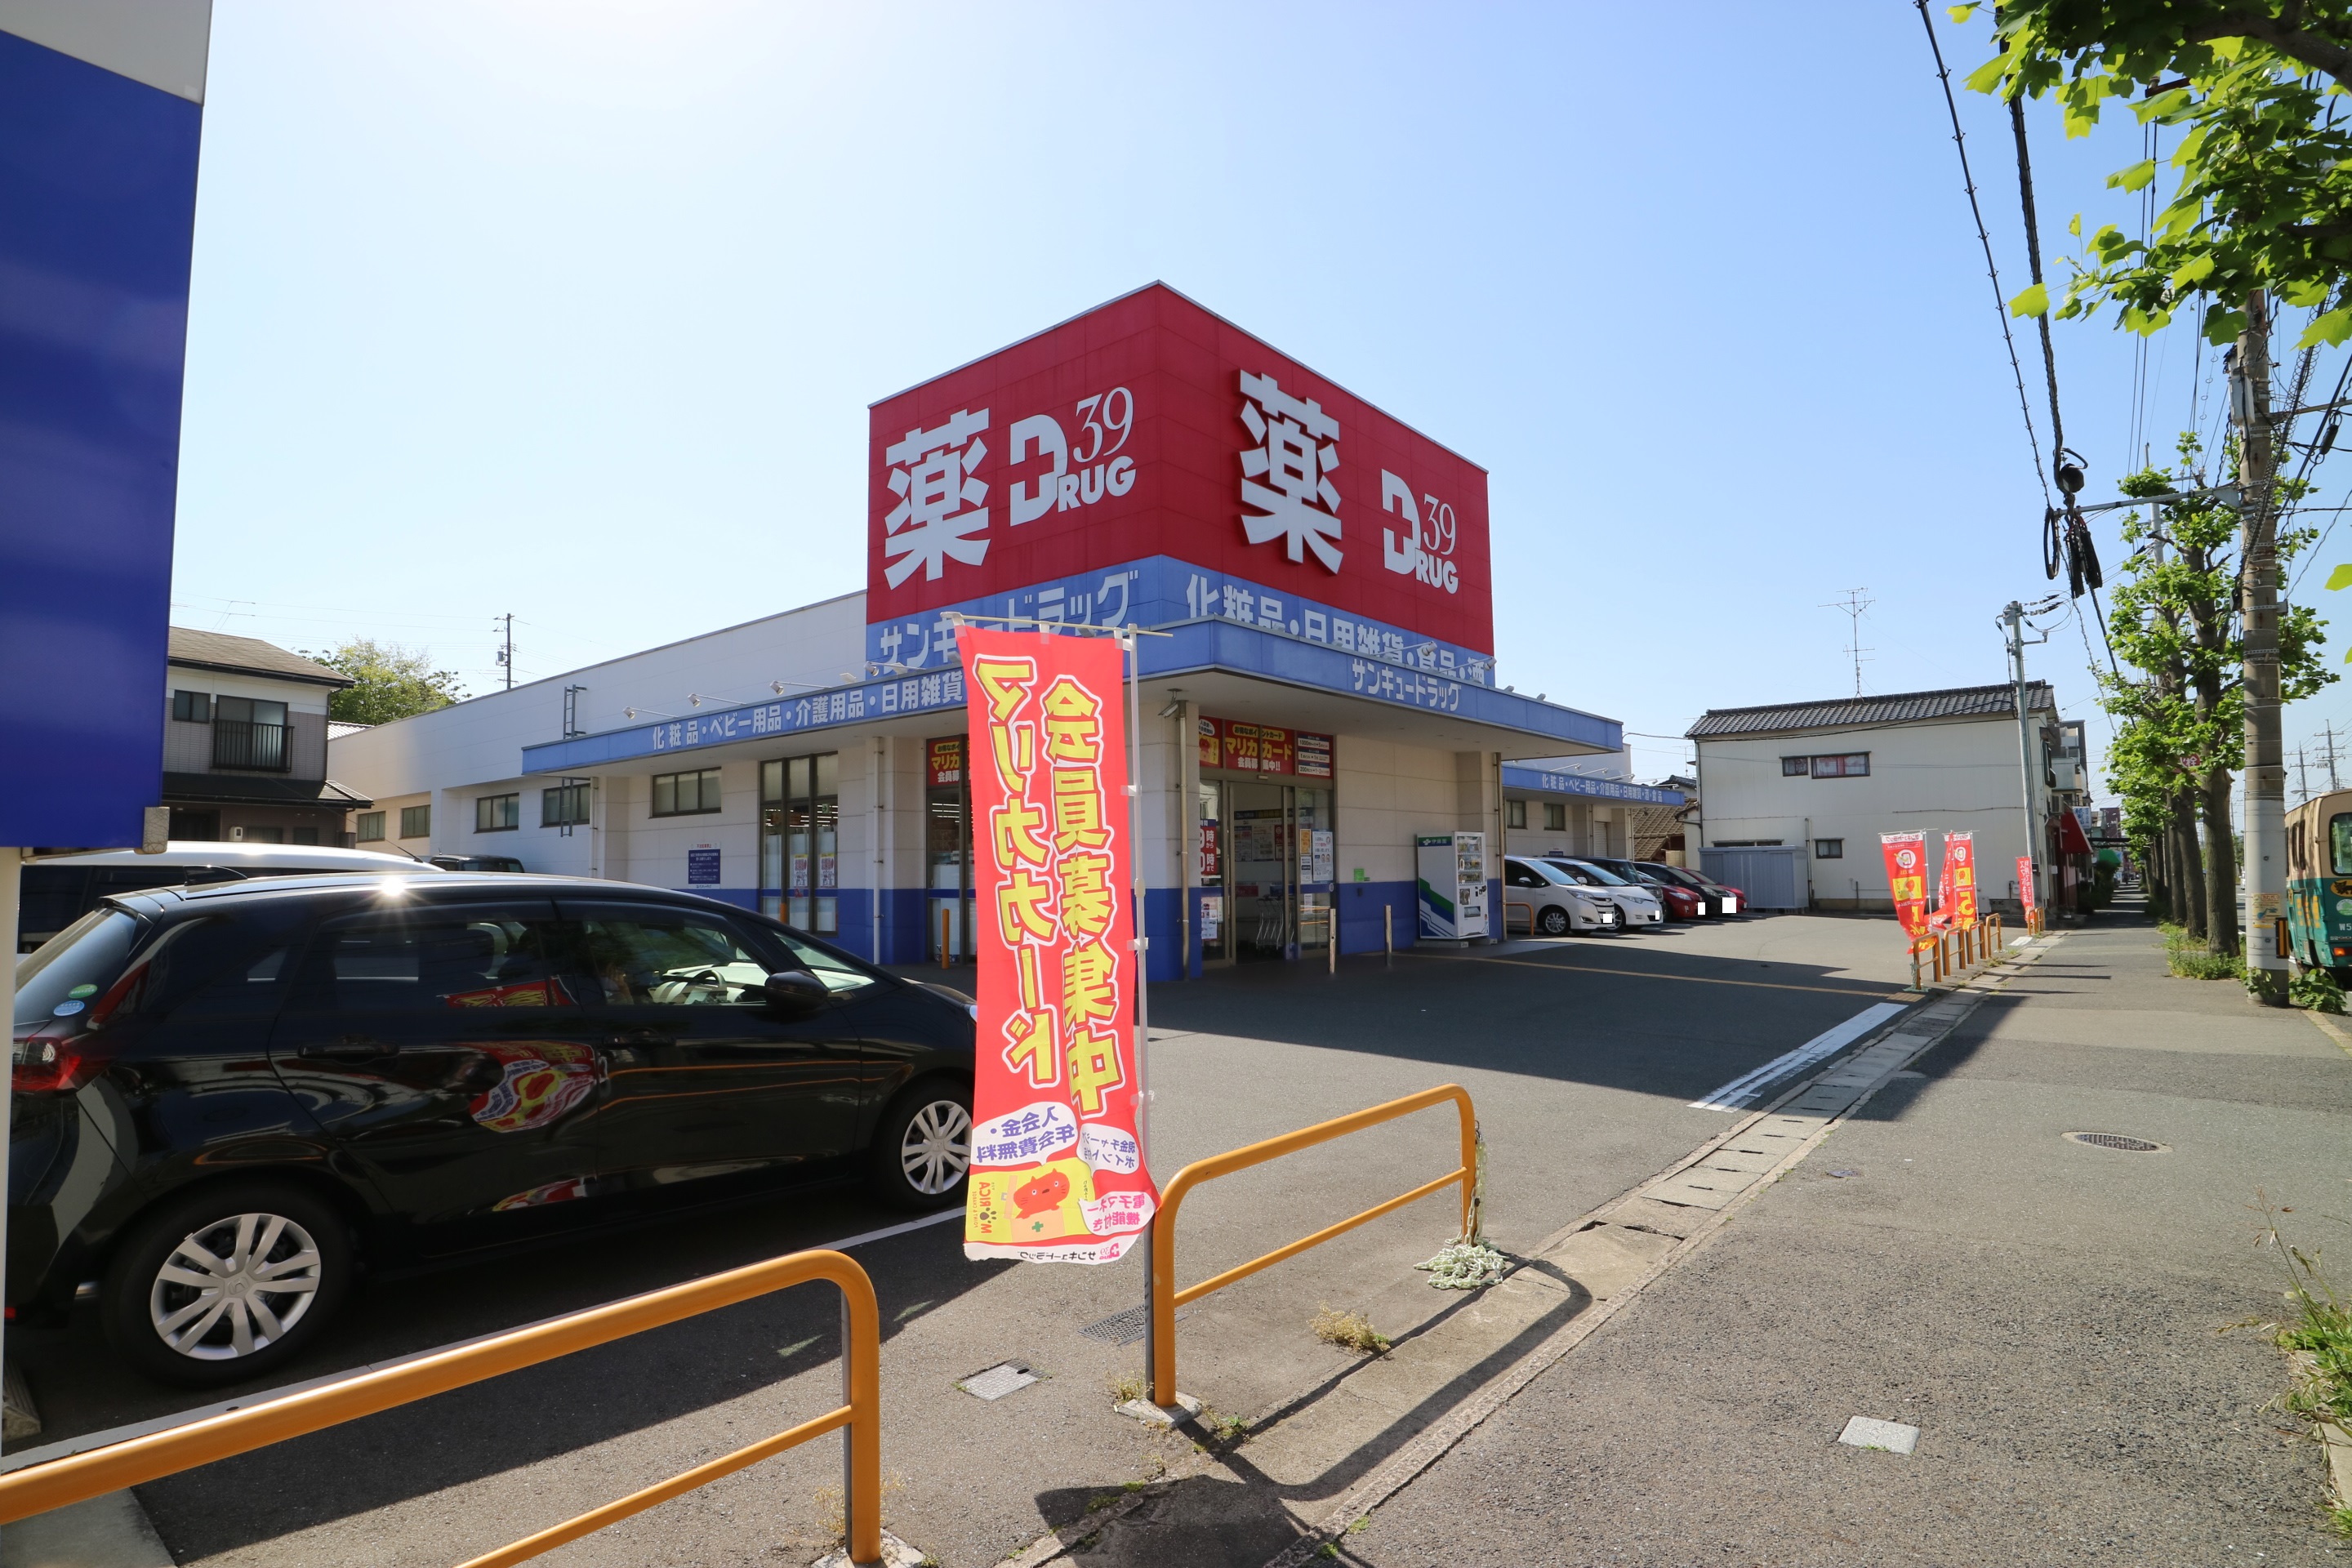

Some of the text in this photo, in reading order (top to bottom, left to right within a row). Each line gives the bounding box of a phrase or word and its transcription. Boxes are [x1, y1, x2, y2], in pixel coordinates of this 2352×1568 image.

[1009, 414, 1137, 527] DRUG
[1072, 386, 1134, 463] 39
[1239, 368, 1343, 576] 薬
[884, 407, 991, 590] 薬
[1380, 468, 1459, 595] DRUG
[1423, 492, 1457, 556] 39
[880, 568, 1138, 674] サンキードラッグ
[1352, 658, 1462, 711] サンキュードラッグ
[1225, 737, 1293, 761] マリカカード
